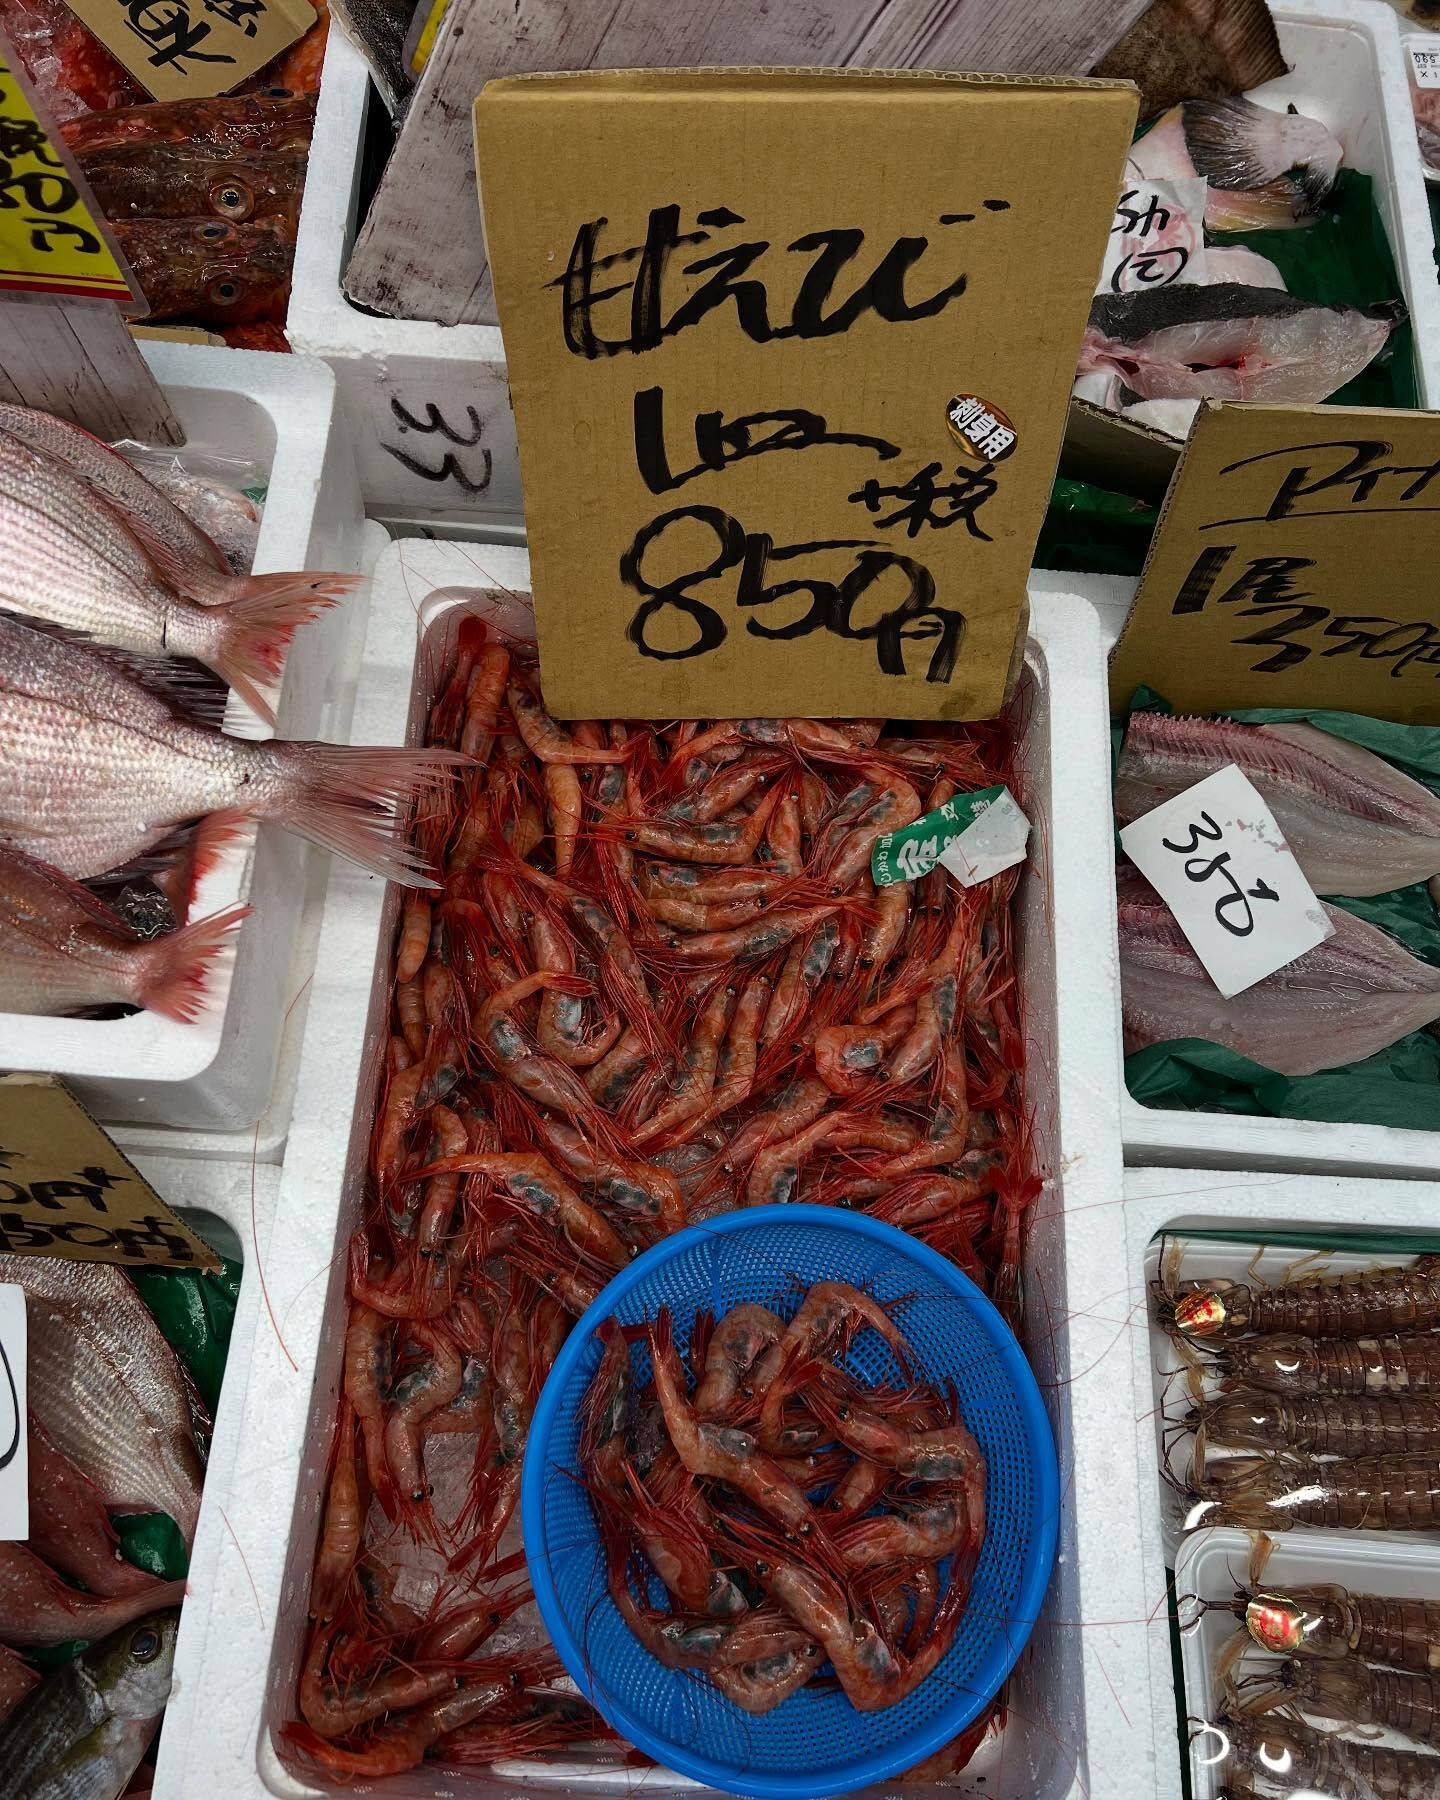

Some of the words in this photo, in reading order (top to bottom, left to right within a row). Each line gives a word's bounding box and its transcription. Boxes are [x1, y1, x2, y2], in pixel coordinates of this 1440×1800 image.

[543, 200, 1011, 359] 甘えび
[949, 397, 1017, 460] 刺身用
[620, 505, 967, 684] 850円
